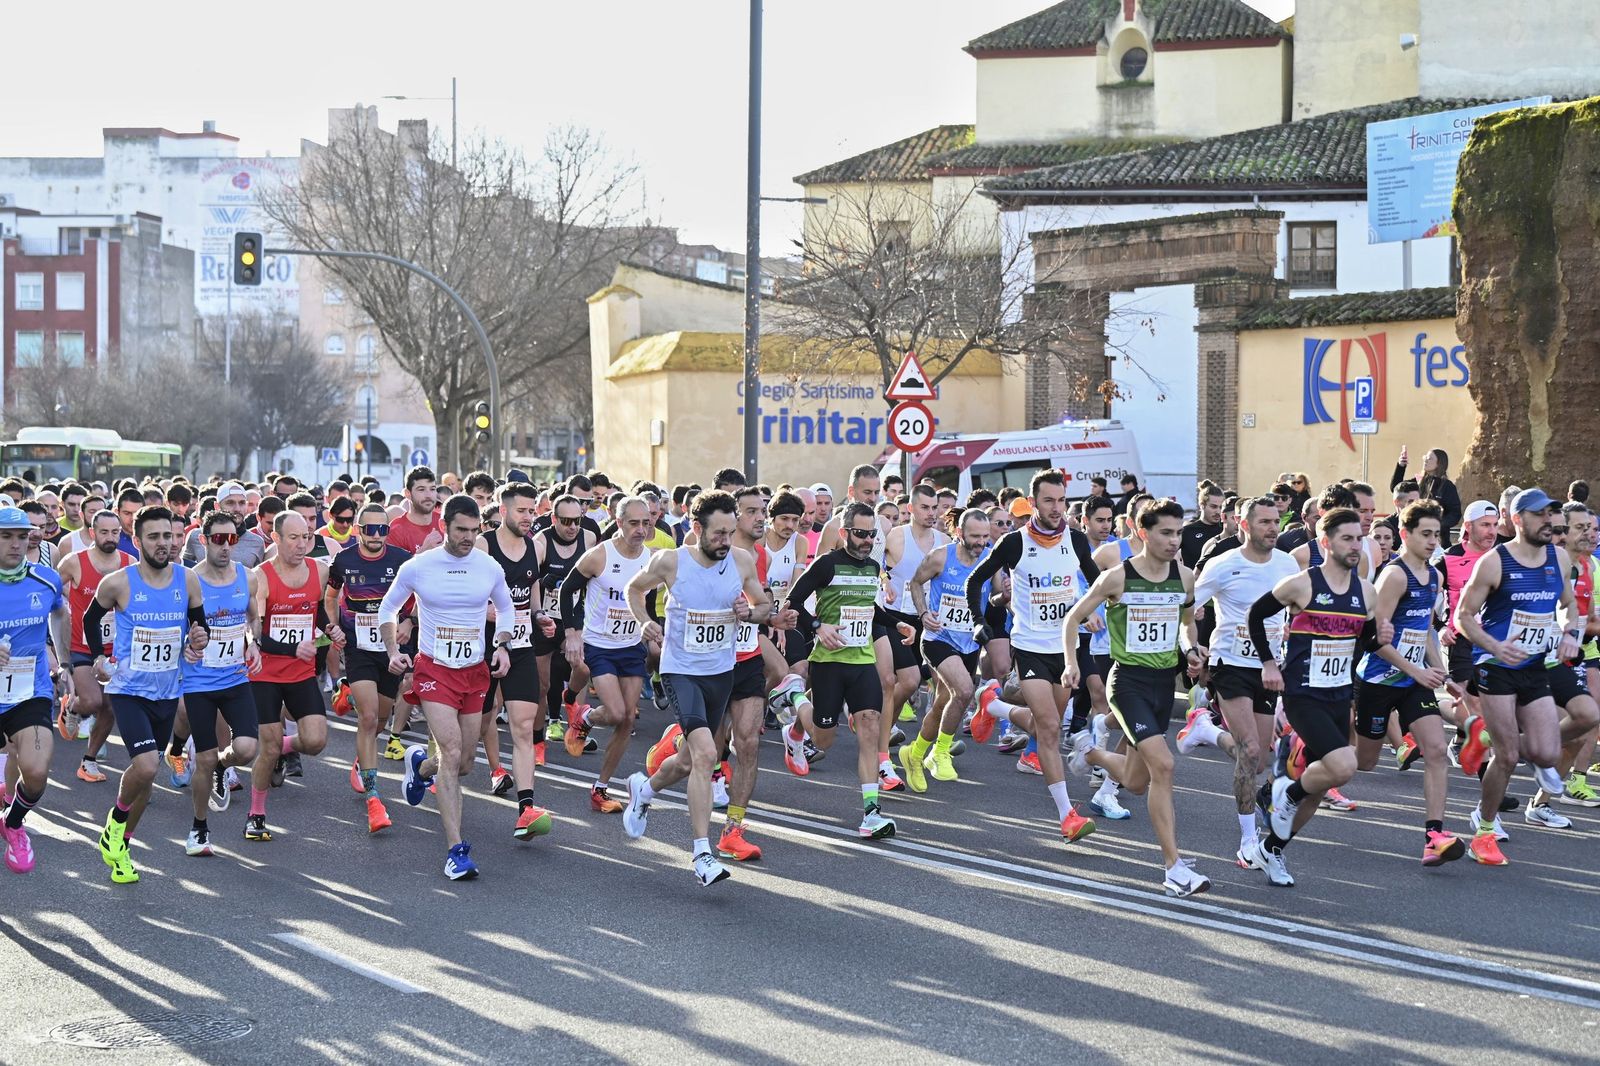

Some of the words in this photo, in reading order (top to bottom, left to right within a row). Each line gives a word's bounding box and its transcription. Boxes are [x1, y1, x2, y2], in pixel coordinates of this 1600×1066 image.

[737, 380, 796, 402] Clegio
[801, 380, 875, 400] Santísima
[1358, 382, 1371, 405] P
[899, 419, 925, 436] 20
[993, 445, 1049, 456] AMBULANCIA
[1076, 470, 1101, 481] Cruz
[1104, 467, 1129, 481] Roja
[1028, 572, 1071, 588] indea
[1031, 592, 1047, 604] XLII
[1511, 591, 1556, 602] enerplus
[688, 612, 705, 625] XLII
[842, 609, 856, 620] XLII
[946, 608, 970, 624] 434
[1039, 603, 1066, 621] 330
[1129, 609, 1148, 622] XLII
[273, 617, 288, 628] XLII
[357, 615, 372, 627] XLII
[612, 620, 637, 634] 210
[850, 621, 867, 637] 103
[134, 630, 152, 643] XLII
[280, 629, 304, 645] 261
[436, 627, 454, 639] XLII
[695, 625, 725, 643] 308
[1138, 622, 1168, 642] 351
[1519, 627, 1545, 644] 479
[142, 644, 172, 662] 213
[218, 640, 235, 659] 74
[446, 641, 472, 659] 176
[1314, 643, 1332, 656] XLII
[1321, 657, 1349, 676] 404
